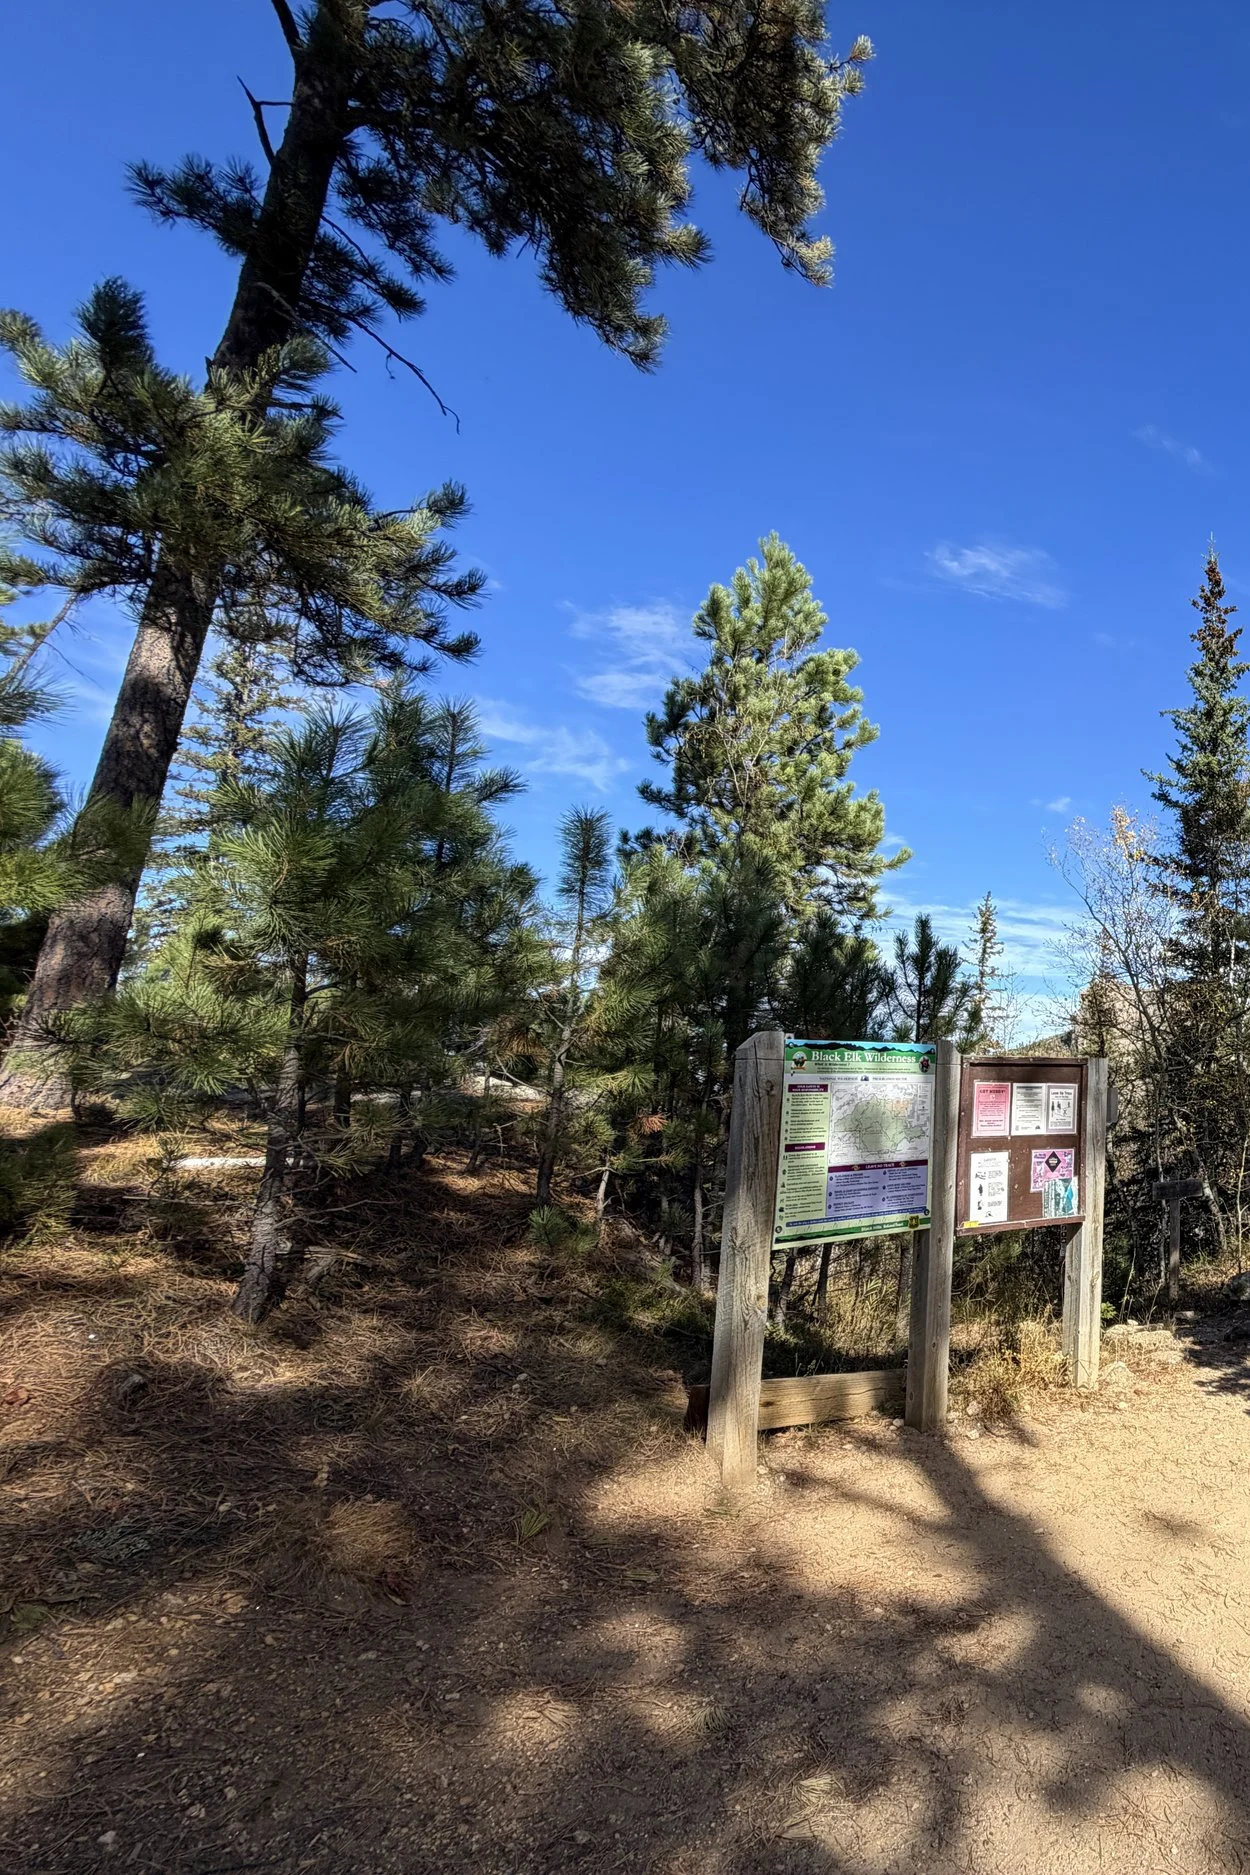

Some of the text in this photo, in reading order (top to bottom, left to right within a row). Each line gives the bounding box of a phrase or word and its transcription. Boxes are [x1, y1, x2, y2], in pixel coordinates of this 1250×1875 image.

[812, 1051, 916, 1063] Black Elk Wilderness
